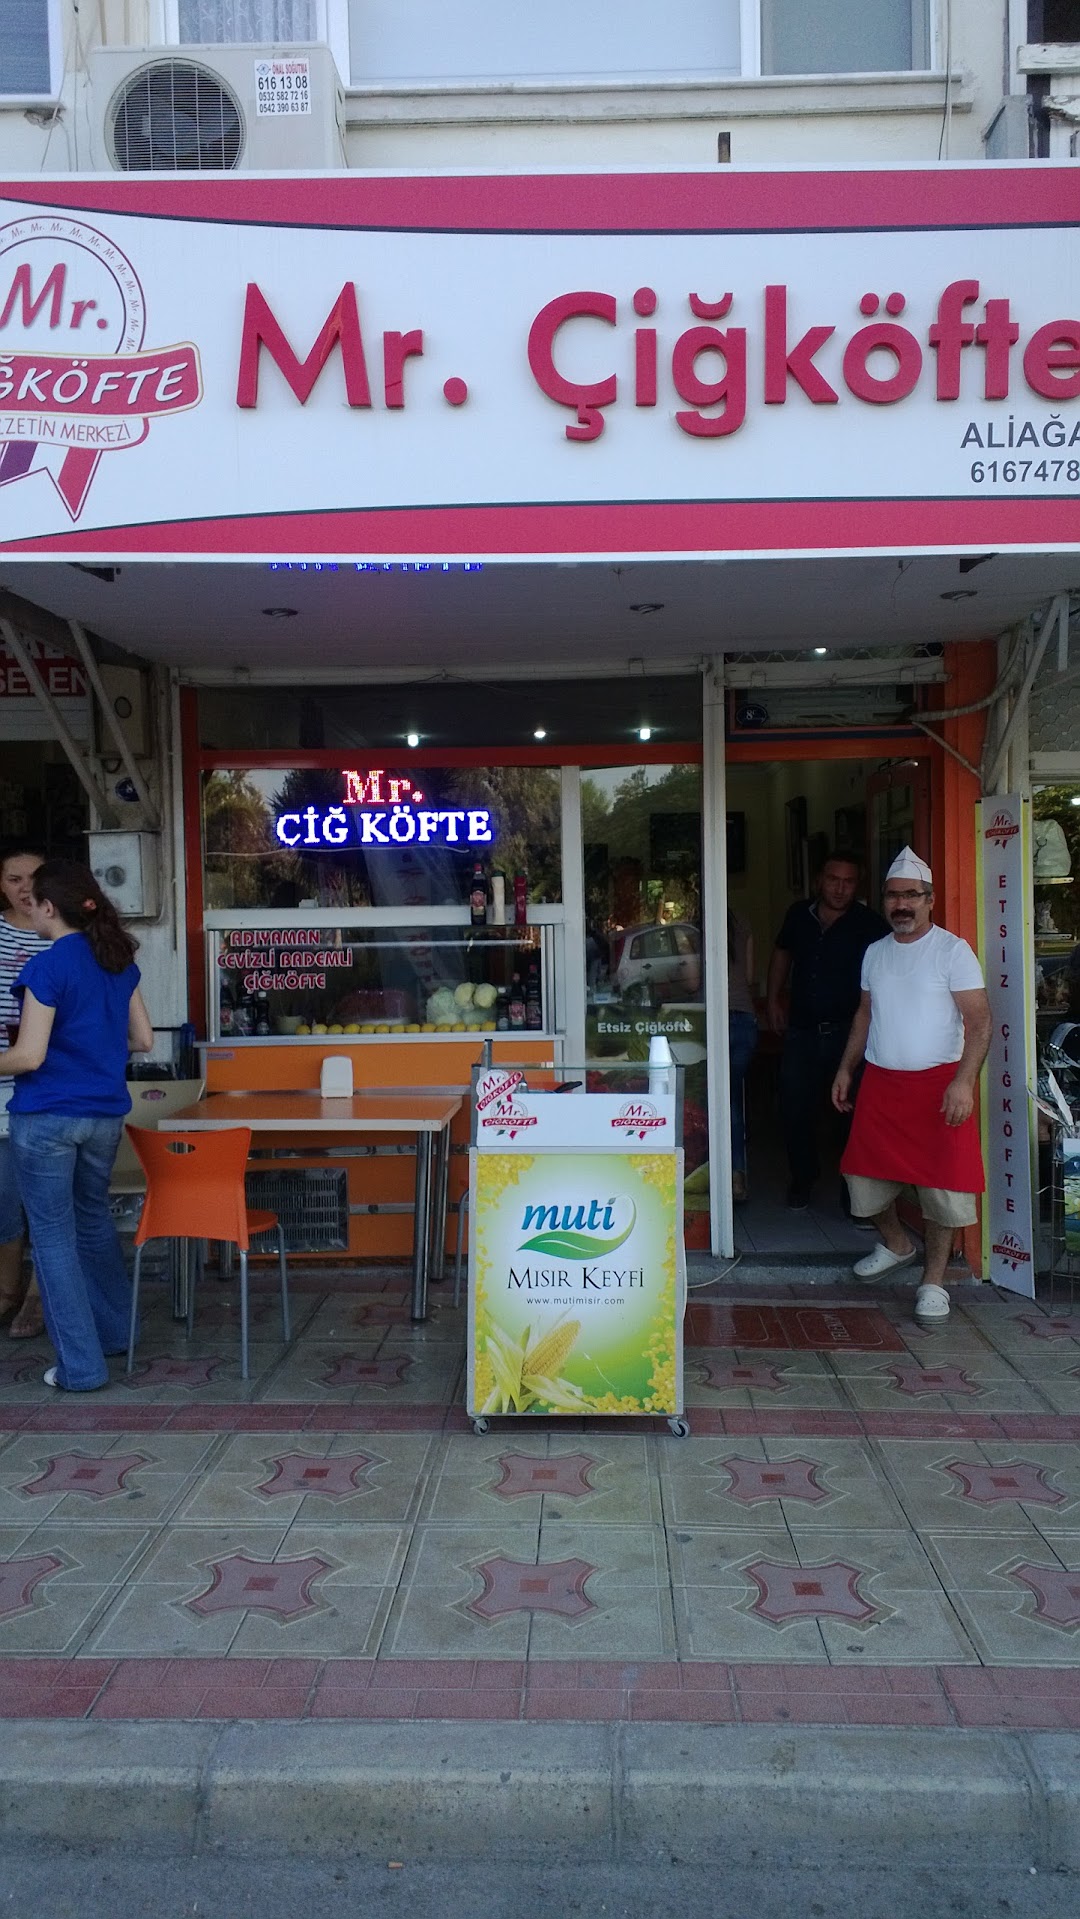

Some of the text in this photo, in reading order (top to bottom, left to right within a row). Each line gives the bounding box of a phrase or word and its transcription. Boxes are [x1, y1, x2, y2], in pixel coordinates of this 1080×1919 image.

[258, 76, 308, 90] 616 13 08
[259, 90, 308, 101] 0532 582 72 16
[259, 102, 308, 113] 0542 390 63 87
[0, 263, 108, 329] Mr.
[236, 279, 1080, 442] Mr. Çiğköfte
[0, 416, 131, 443] ZETİN MERKEZİ
[971, 460, 1080, 482] 6167478
[342, 770, 423, 804] Mr.
[360, 806, 492, 842] KÖFTE
[230, 929, 320, 946] ADIYAMAN
[217, 947, 352, 968] CEVİZLİ BADEMLİ
[244, 970, 326, 994] ÇİĞKÖFTE
[597, 1022, 632, 1034] Etsiz
[998, 874, 1014, 1213] ETSİZ ÇİĞKÖFTE
[482, 1076, 505, 1094] Mr.
[496, 1105, 523, 1116] Mr.
[626, 1104, 652, 1117] Mr.
[521, 1198, 616, 1230] muti
[582, 1266, 644, 1290] KEYFİ
[526, 1296, 624, 1305] www.mutimisir.com
